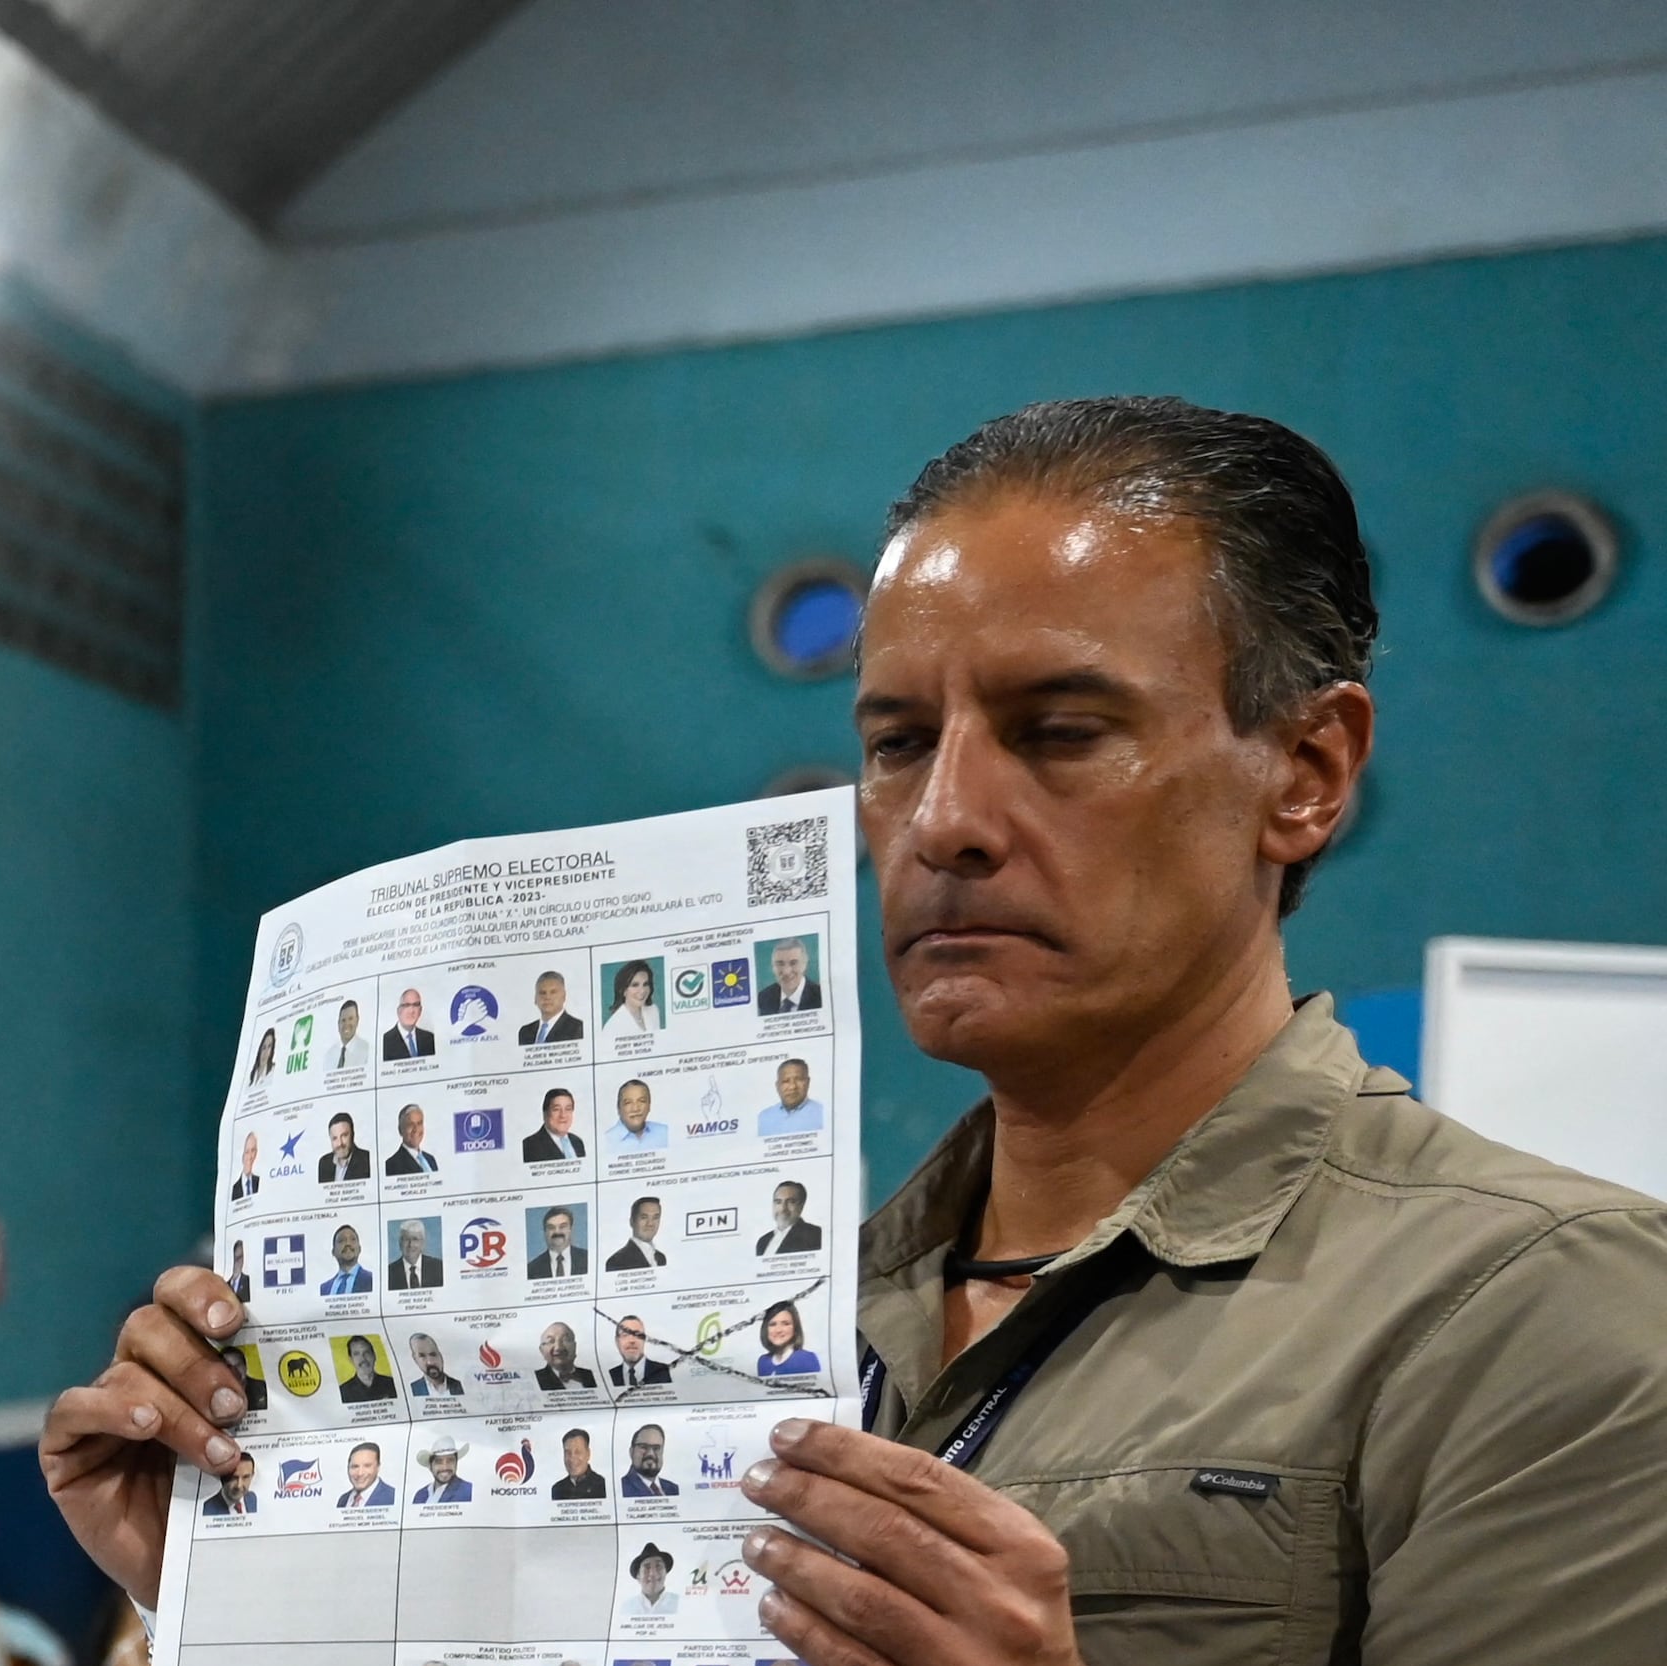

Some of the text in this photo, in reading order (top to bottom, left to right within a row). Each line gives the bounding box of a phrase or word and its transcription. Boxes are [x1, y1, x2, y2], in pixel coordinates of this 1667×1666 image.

[370, 851, 615, 903] TRIBUNAL SUPREMO ELECTORAL
[366, 868, 616, 917] ELECCIÓN DE PRESIDENTE Y VICEPRESIDENTE
[415, 892, 546, 919] DE LA REPÚBLICA -2023-
[361, 929, 396, 944] MARCARSE
[398, 928, 408, 936] UN
[410, 923, 429, 934] SOLO
[430, 916, 458, 930] CUADRO
[459, 913, 475, 923] CON
[478, 910, 497, 921] UNA
[523, 905, 536, 917] UN
[539, 900, 581, 915] CÍRCULO
[584, 900, 590, 909] U
[593, 897, 619, 908] OTRO
[622, 892, 651, 904] SIGNO
[351, 948, 363, 959] QUE
[398, 936, 421, 948] OTROS
[423, 928, 456, 943] CUADROS
[464, 921, 517, 935] CUALQUIER
[520, 916, 557, 930] APUNTE
[561, 916, 567, 924] O
[570, 907, 638, 924] MODIFICACIÓN
[640, 899, 683, 914] ANULARÁ
[685, 897, 696, 907] EL
[698, 893, 723, 905] VOTO
[717, 928, 754, 940] PARTIDOS
[381, 953, 386, 961] A
[387, 949, 411, 960] MENOS
[414, 946, 427, 956] QUE
[430, 944, 438, 954] LA
[440, 936, 481, 951] INTENCIÓN
[484, 935, 501, 945] DEL
[509, 932, 530, 943] VOTO
[533, 931, 551, 941] SEA
[673, 999, 708, 1010] VALOR
[286, 1051, 309, 1074] UNE
[678, 1054, 711, 1064] PARTIDO
[700, 1059, 745, 1071] GUATEMALA
[447, 1078, 509, 1090] PARTIDO POLITICO
[686, 1119, 739, 1136] VAMOS
[463, 1140, 495, 1150] TODOS
[269, 1164, 305, 1178] CABAL
[646, 1166, 780, 1187] PARTIDO INTEGRACION NACIONAL
[471, 1195, 523, 1206] REPUBLICANO
[301, 1212, 338, 1222] GUATEMALA
[696, 1214, 728, 1229] PIN
[461, 1271, 508, 1280] REPUBLICANO
[677, 1290, 744, 1302] PARTIDO POLITICO
[671, 1298, 750, 1310] MOVIMIENTO SEMILLA
[454, 1312, 518, 1323] PARTIDO POLITICO
[289, 1326, 317, 1335] POLITICO
[469, 1321, 502, 1329] VICTORIA
[474, 1372, 521, 1382] VICTORIA
[962, 1385, 1008, 1440] CENTRAL
[298, 1471, 318, 1481] FCN
[1210, 1472, 1267, 1492] Columbia
[274, 1487, 322, 1500] NACIÓN
[491, 1486, 537, 1496] NOSOTROS
[479, 1646, 511, 1654] PARTIDO
